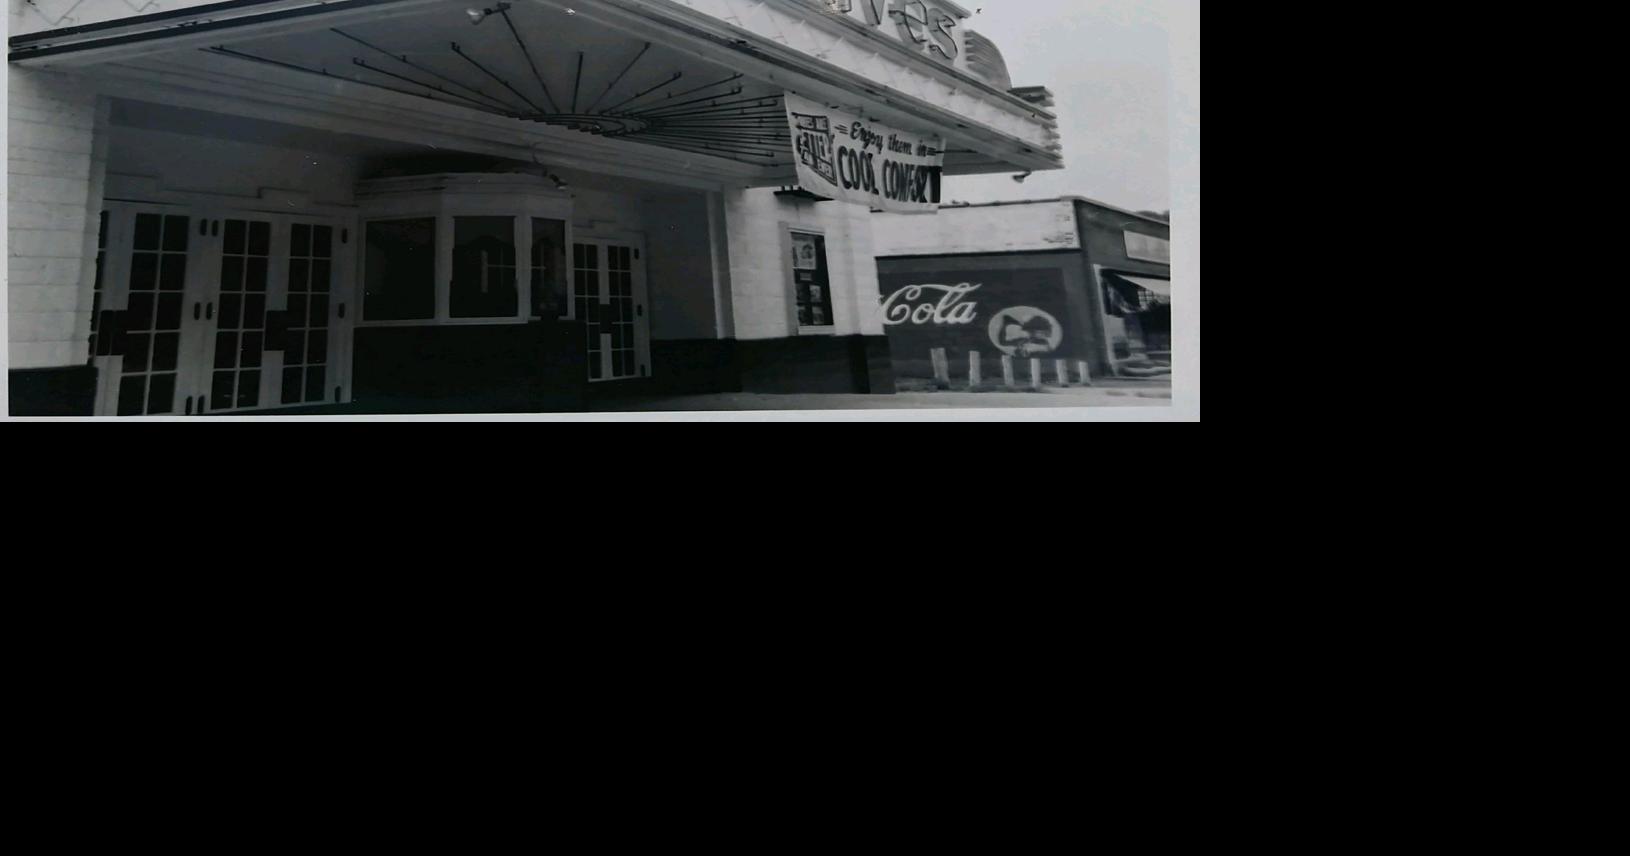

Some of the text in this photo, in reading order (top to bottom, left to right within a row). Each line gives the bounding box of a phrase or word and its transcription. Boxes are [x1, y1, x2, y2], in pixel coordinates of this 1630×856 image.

[850, 121, 884, 154] Enjoy
[888, 133, 913, 155] them
[916, 139, 927, 157] in
[838, 146, 879, 195] COOL
